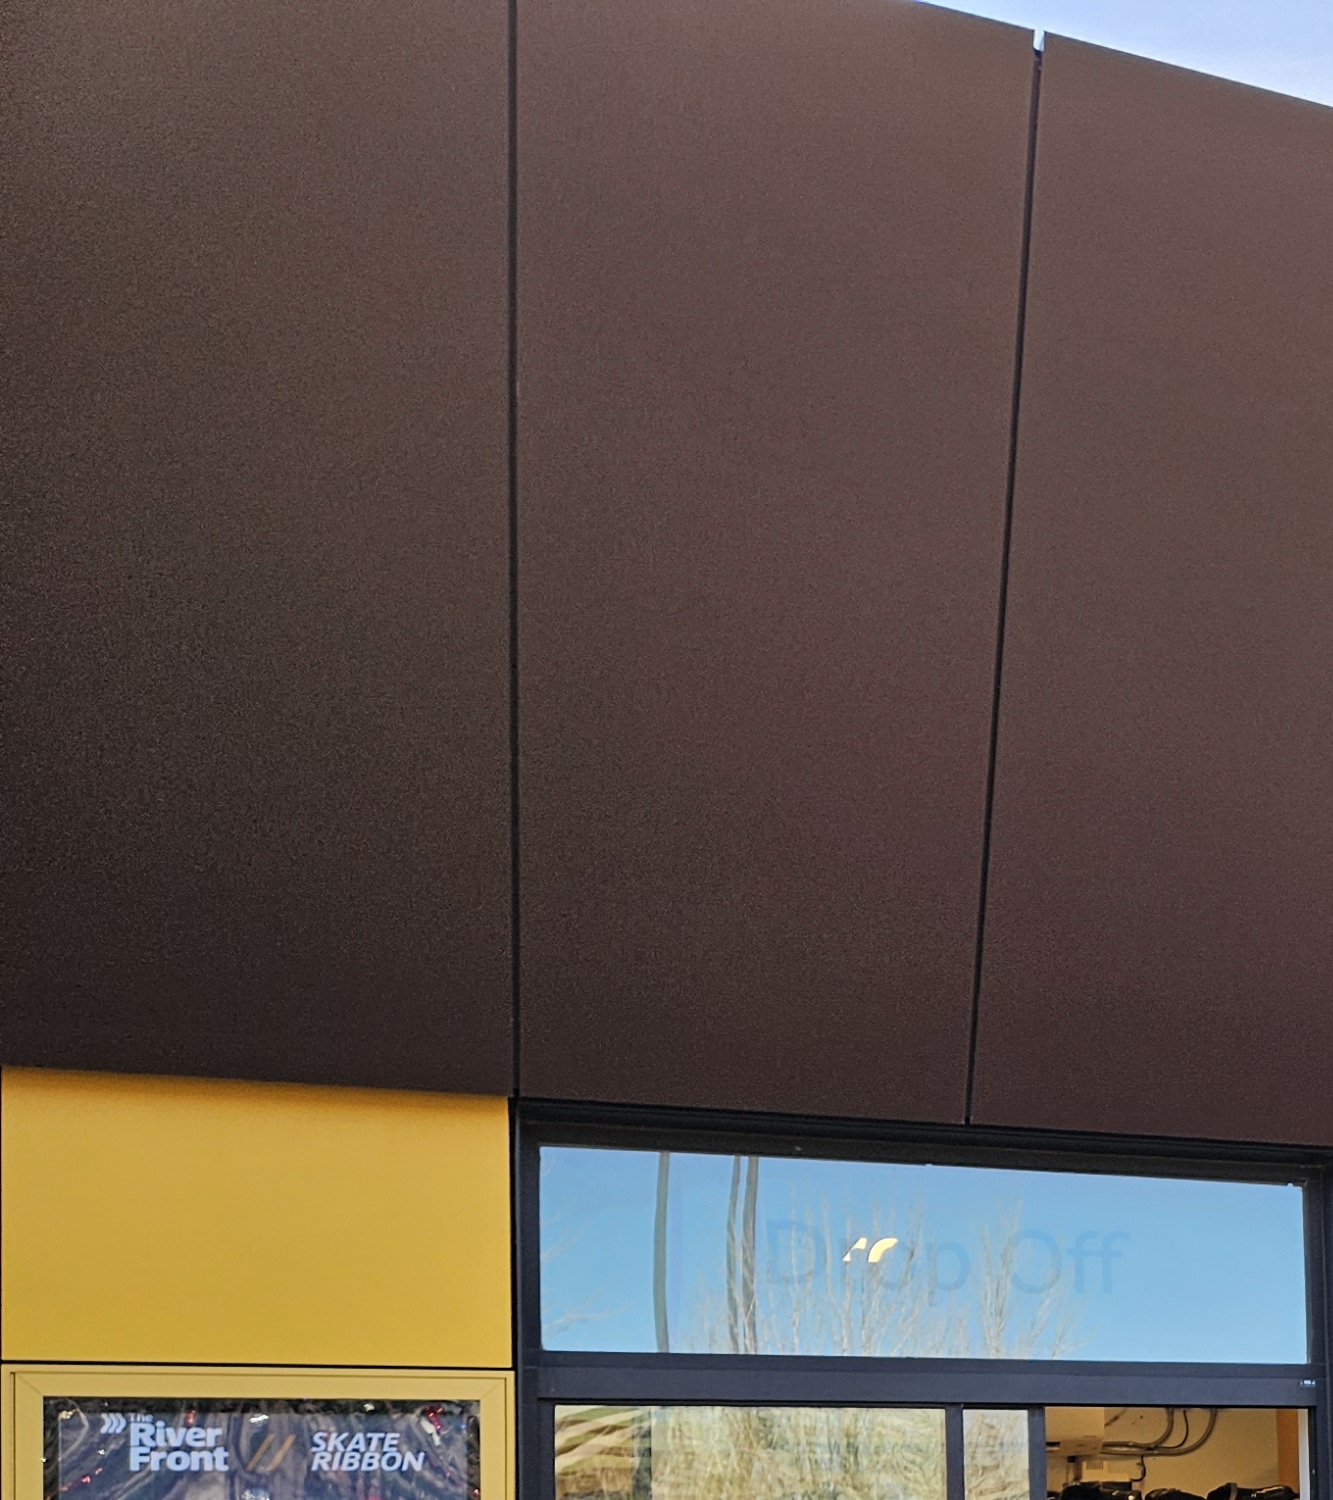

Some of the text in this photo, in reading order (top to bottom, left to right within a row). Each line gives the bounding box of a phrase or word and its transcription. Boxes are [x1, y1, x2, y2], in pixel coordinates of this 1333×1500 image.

[765, 1219, 1132, 1308] Drop Off
[129, 1420, 222, 1448] River
[310, 1431, 400, 1452] SKATE
[129, 1447, 229, 1472] Front
[310, 1451, 426, 1472] RIBBON
